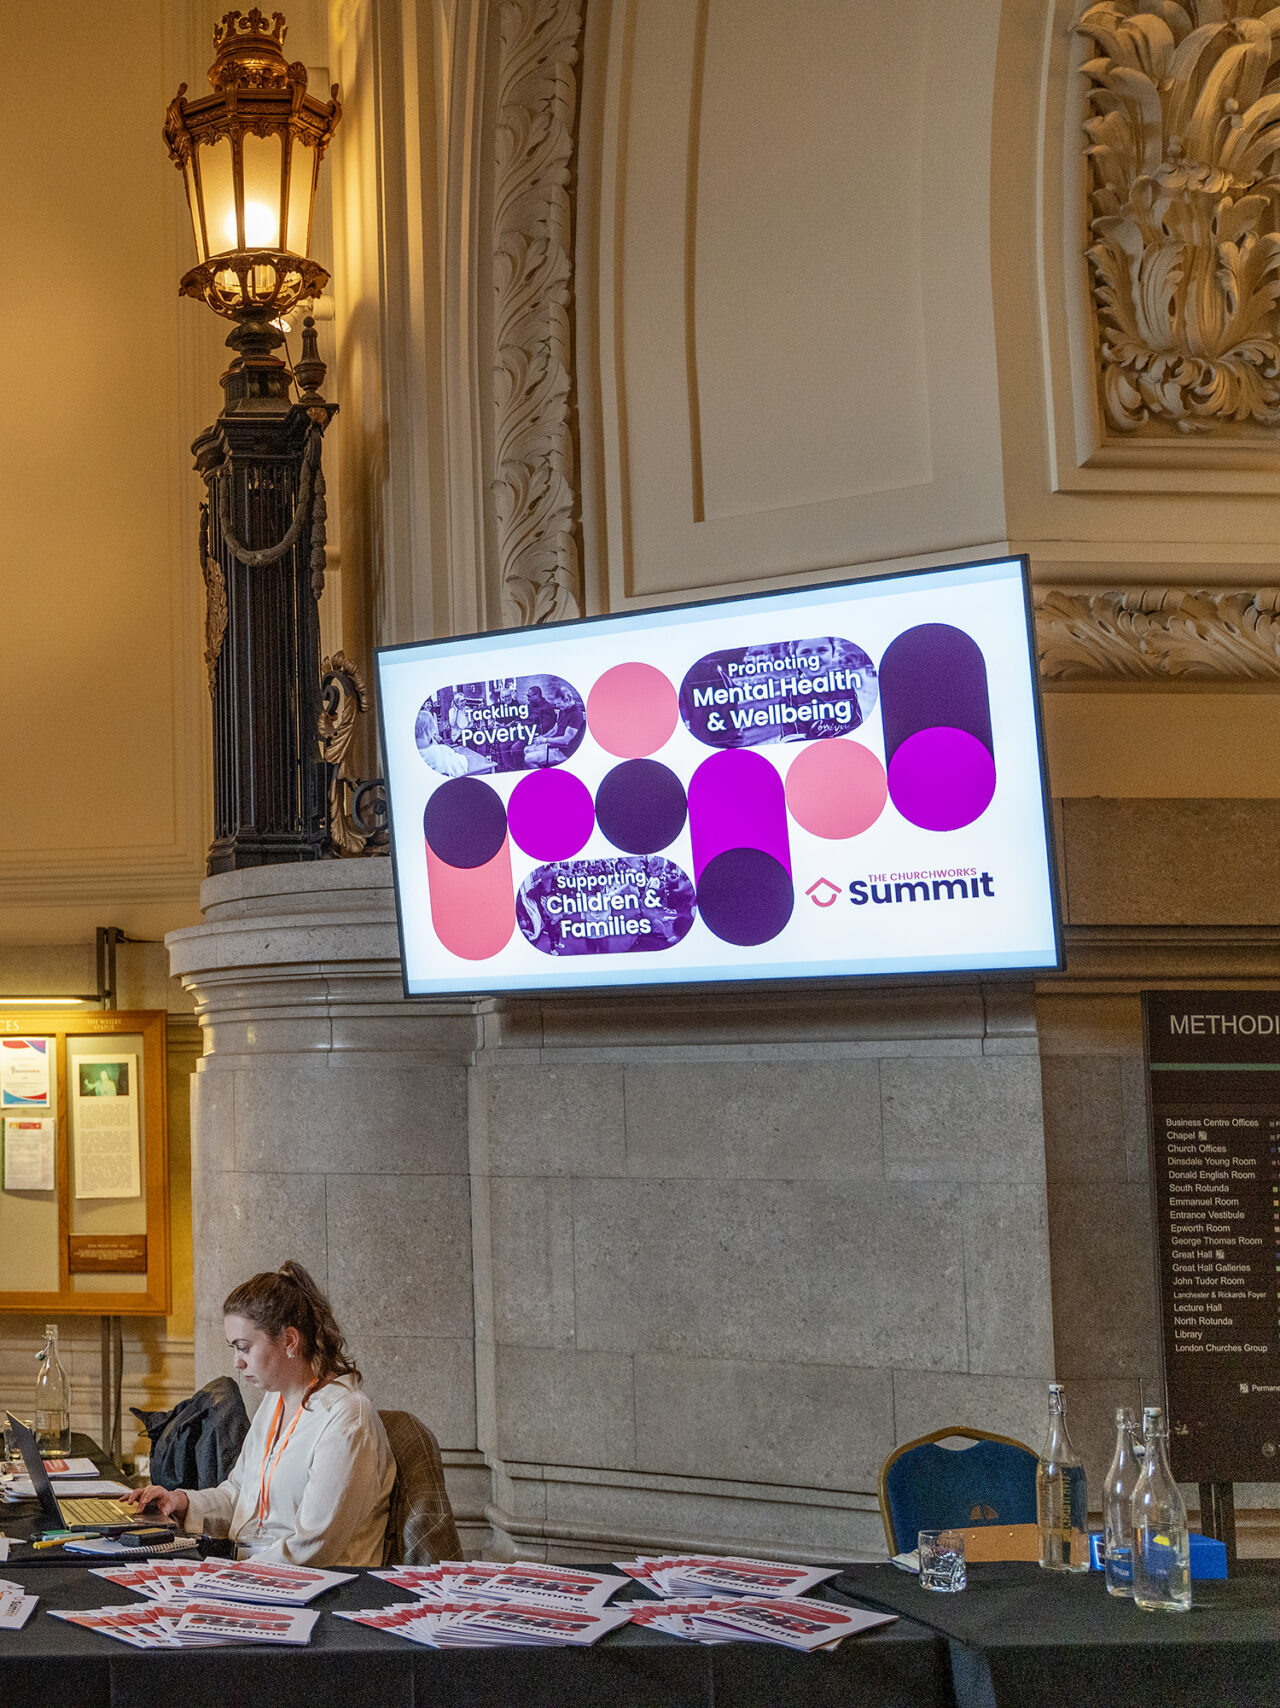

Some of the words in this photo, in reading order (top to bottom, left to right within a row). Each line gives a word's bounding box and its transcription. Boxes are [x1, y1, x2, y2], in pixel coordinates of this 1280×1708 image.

[728, 654, 820, 677] Promoting
[692, 678, 775, 708] Mental
[780, 669, 862, 697] Health
[465, 703, 529, 721] Tackling
[707, 711, 727, 732] &
[729, 699, 852, 731] Wellbeing
[461, 724, 537, 747] Poverty
[557, 870, 647, 891] Supporting
[868, 873, 887, 883] THE
[890, 867, 977, 881] CHURCHWORKS
[849, 871, 995, 905] Summit
[546, 891, 639, 914] Children
[643, 888, 662, 908] &
[560, 915, 652, 939] Families
[1169, 1014, 1280, 1035] METHODI
[1166, 1118, 1201, 1127] Business
[1203, 1118, 1230, 1127] Centre
[1231, 1118, 1259, 1127] Offices
[1166, 1131, 1195, 1141] Chapel
[1167, 1144, 1197, 1153] Church
[1198, 1144, 1227, 1153] Offices
[1167, 1157, 1203, 1166] Dinsdale
[1204, 1157, 1231, 1167] Young
[1232, 1157, 1257, 1166] Room
[1168, 1171, 1197, 1179] Donald
[1199, 1171, 1229, 1181] English
[1231, 1171, 1256, 1179] Room
[1169, 1183, 1193, 1192] South
[1195, 1183, 1230, 1192] Rotunda
[1169, 1197, 1213, 1206] Emmanuel
[1214, 1197, 1239, 1206] Room
[1170, 1210, 1206, 1219] Entrance
[1208, 1210, 1245, 1219] Vestibule
[1170, 1223, 1204, 1233] Epworth
[1206, 1223, 1231, 1232] Room
[1171, 1236, 1202, 1247] George
[1204, 1236, 1236, 1245] Thomas
[1238, 1236, 1263, 1245] Room
[1172, 1250, 1195, 1259] Great
[1197, 1250, 1213, 1259] Hall
[1172, 1264, 1195, 1272] Great
[1197, 1263, 1213, 1272] Hall
[1215, 1263, 1251, 1272] Galleries
[1173, 1276, 1193, 1285] John
[1195, 1276, 1219, 1285] Tudor
[1220, 1276, 1245, 1285] Room
[1173, 1291, 1209, 1299] Lanchester
[1211, 1291, 1216, 1299] &
[1218, 1291, 1246, 1299] Rickards
[1248, 1291, 1267, 1300] Foyer
[1174, 1303, 1204, 1312] Lecture
[1206, 1303, 1223, 1312] Hall
[1174, 1317, 1197, 1326] North
[1199, 1316, 1233, 1326] Rotunda
[1174, 1330, 1203, 1340] Library
[1175, 1343, 1204, 1352] London
[1205, 1343, 1242, 1352] Churches
[1243, 1343, 1268, 1354] Group
[204, 1578, 295, 1595] programme
[686, 1574, 781, 1592] programme
[488, 1584, 583, 1602] programme
[184, 1624, 287, 1637] programme
[472, 1619, 574, 1637] programme
[706, 1612, 801, 1639] programme
